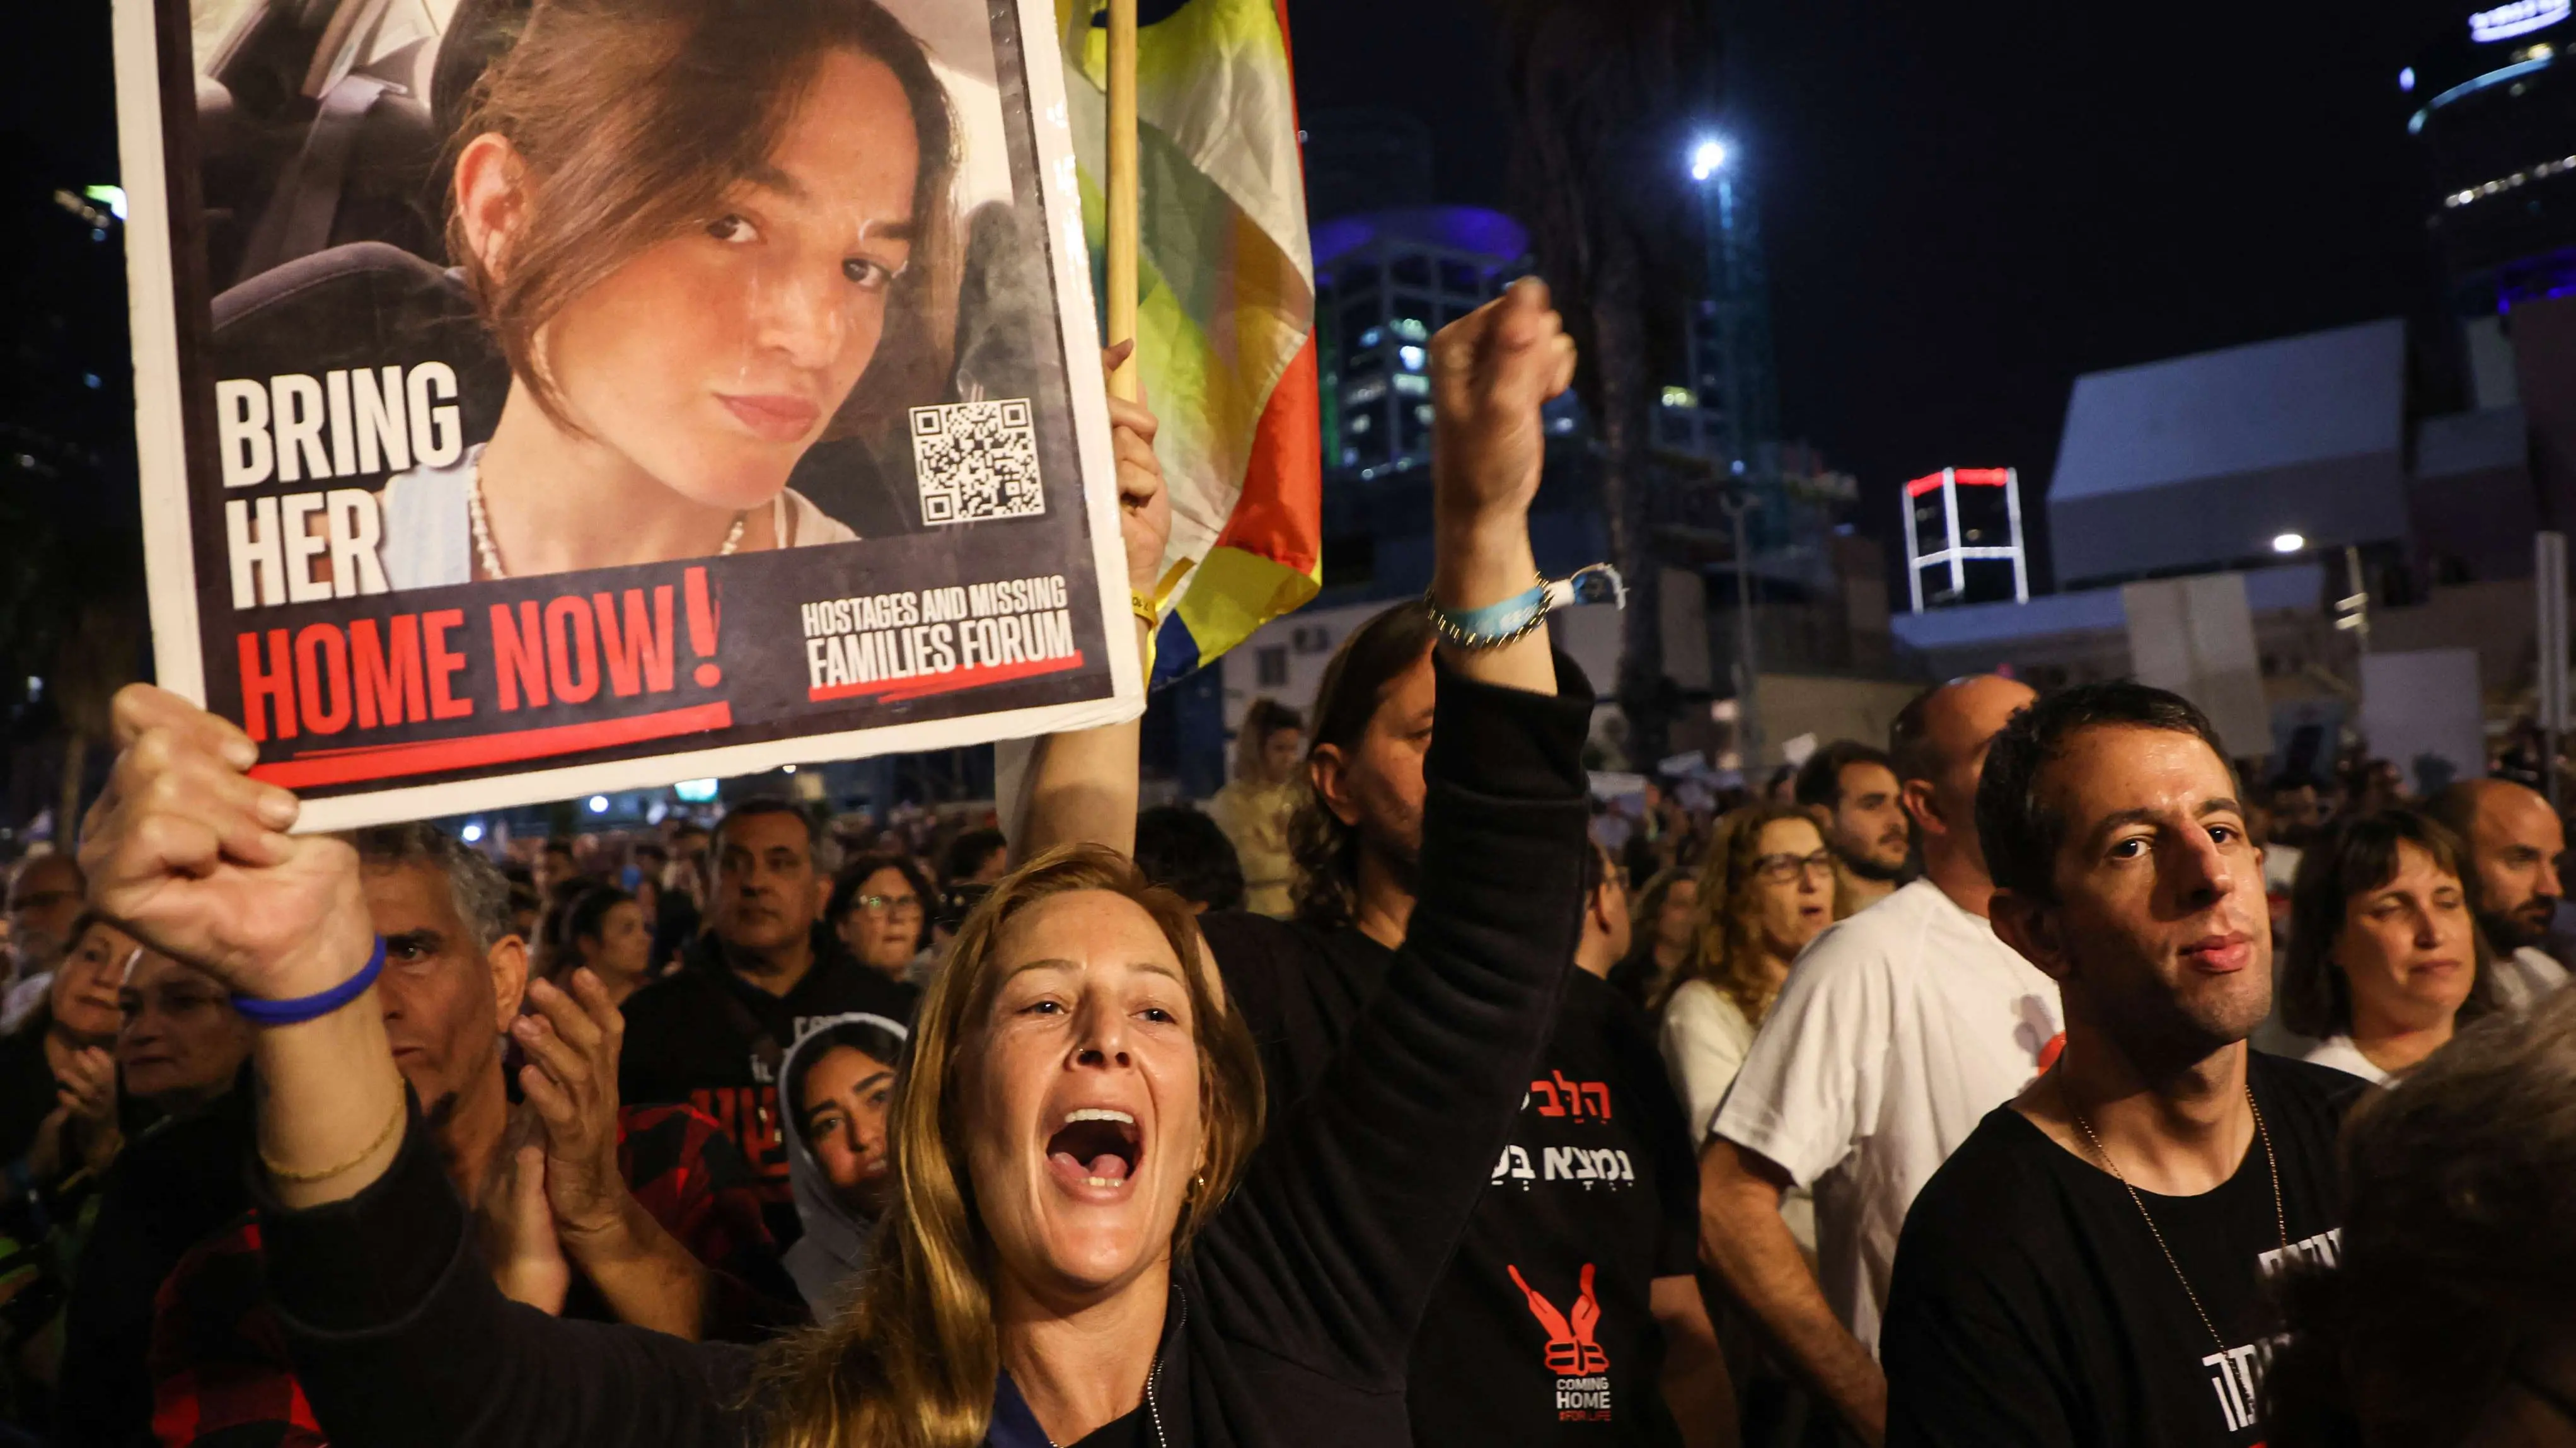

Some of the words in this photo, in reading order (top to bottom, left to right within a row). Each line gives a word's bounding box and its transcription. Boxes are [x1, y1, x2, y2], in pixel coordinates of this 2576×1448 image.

[216, 361, 462, 488] BRING
[225, 489, 390, 610] HER
[801, 593, 919, 637] HOSTAGES
[920, 586, 968, 625] AND
[969, 576, 1068, 617] MISSING
[238, 609, 473, 742] HOME
[490, 566, 722, 712] NOW!
[806, 623, 959, 688] FAMILIES
[958, 610, 1075, 669] FORUM
[1556, 1377, 1609, 1391] COMING
[1556, 1391, 1611, 1409] HOME
